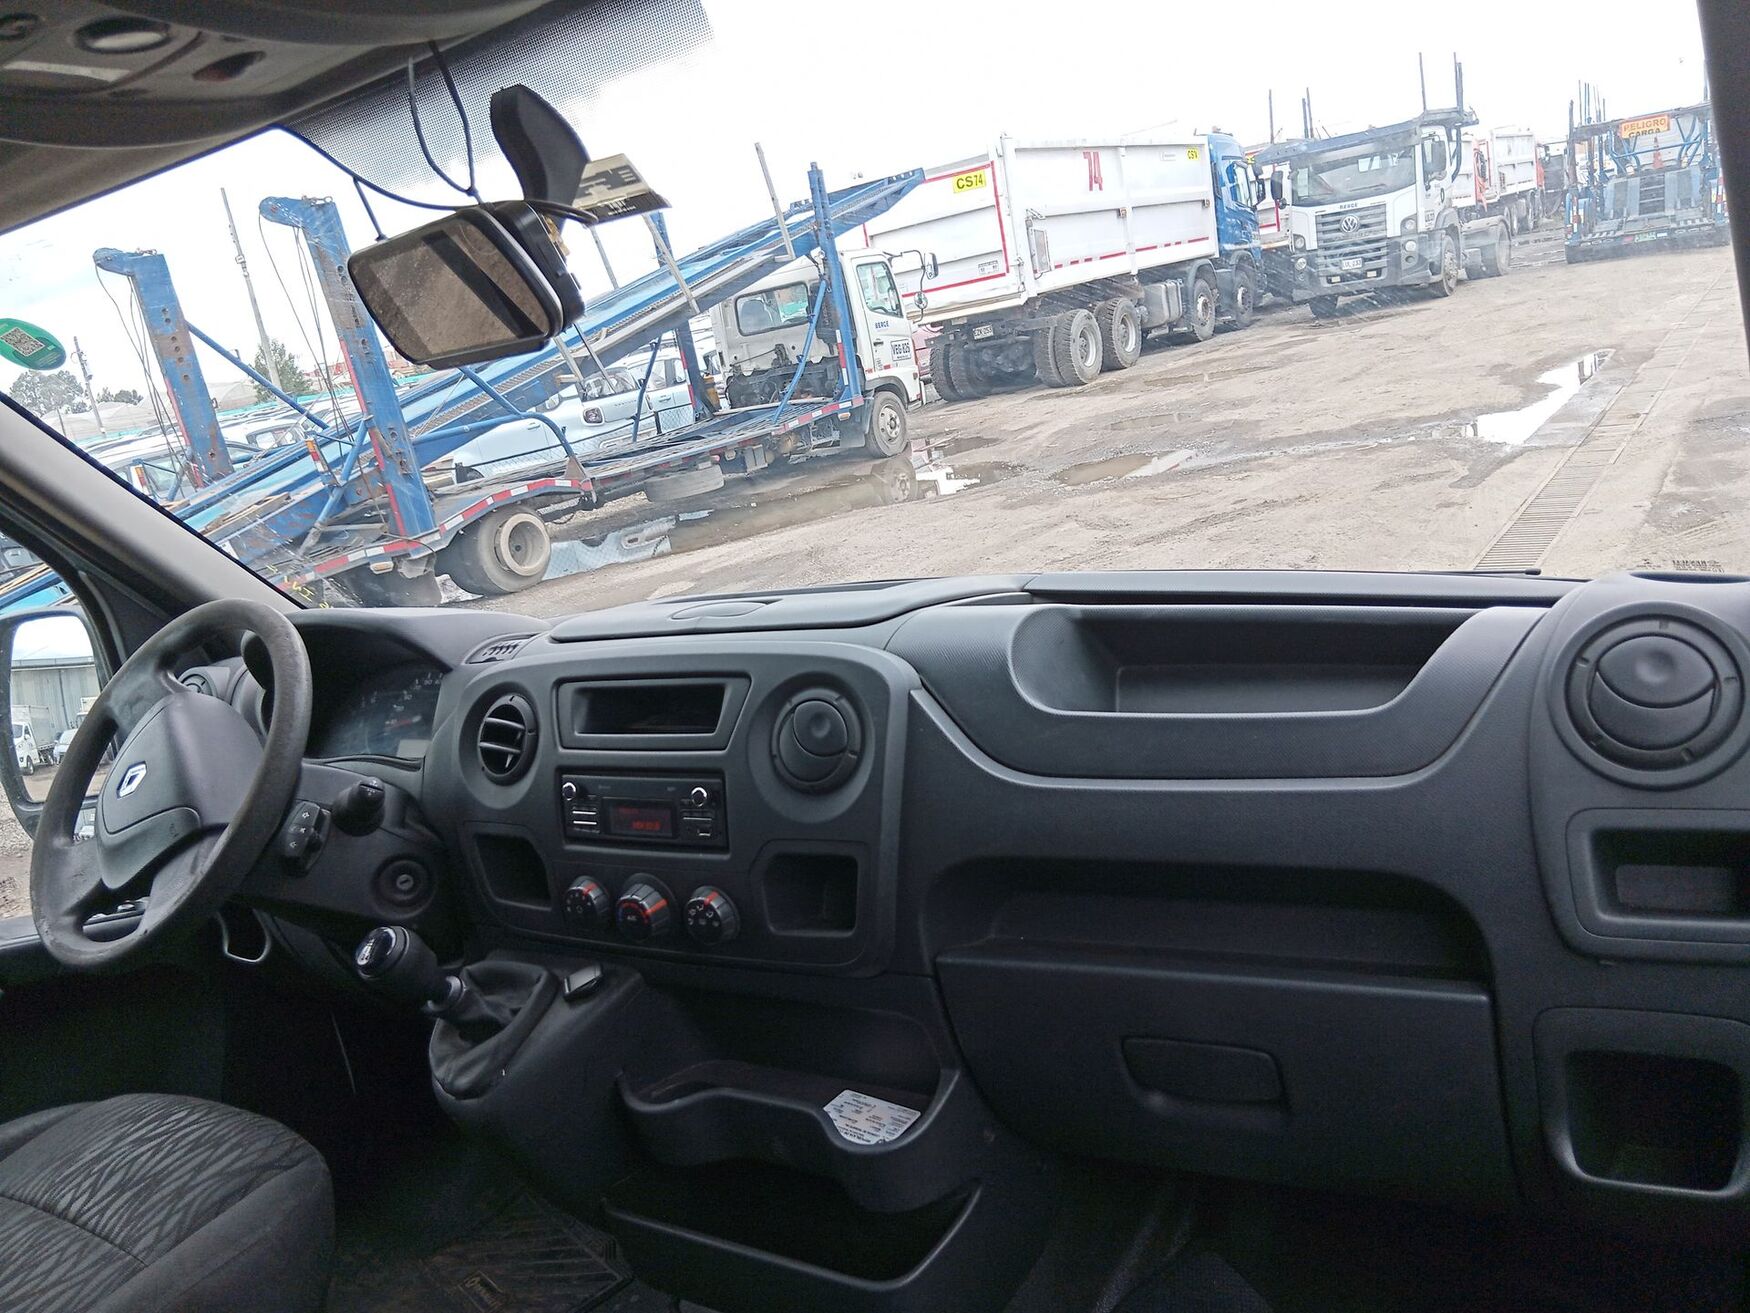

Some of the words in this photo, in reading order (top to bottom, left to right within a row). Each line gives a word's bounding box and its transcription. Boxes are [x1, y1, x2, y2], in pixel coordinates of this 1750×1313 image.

[1624, 118, 1666, 131] PELIGRO
[1628, 128, 1661, 138] CARGA
[1083, 151, 1103, 191] 74
[956, 173, 984, 190] CS74
